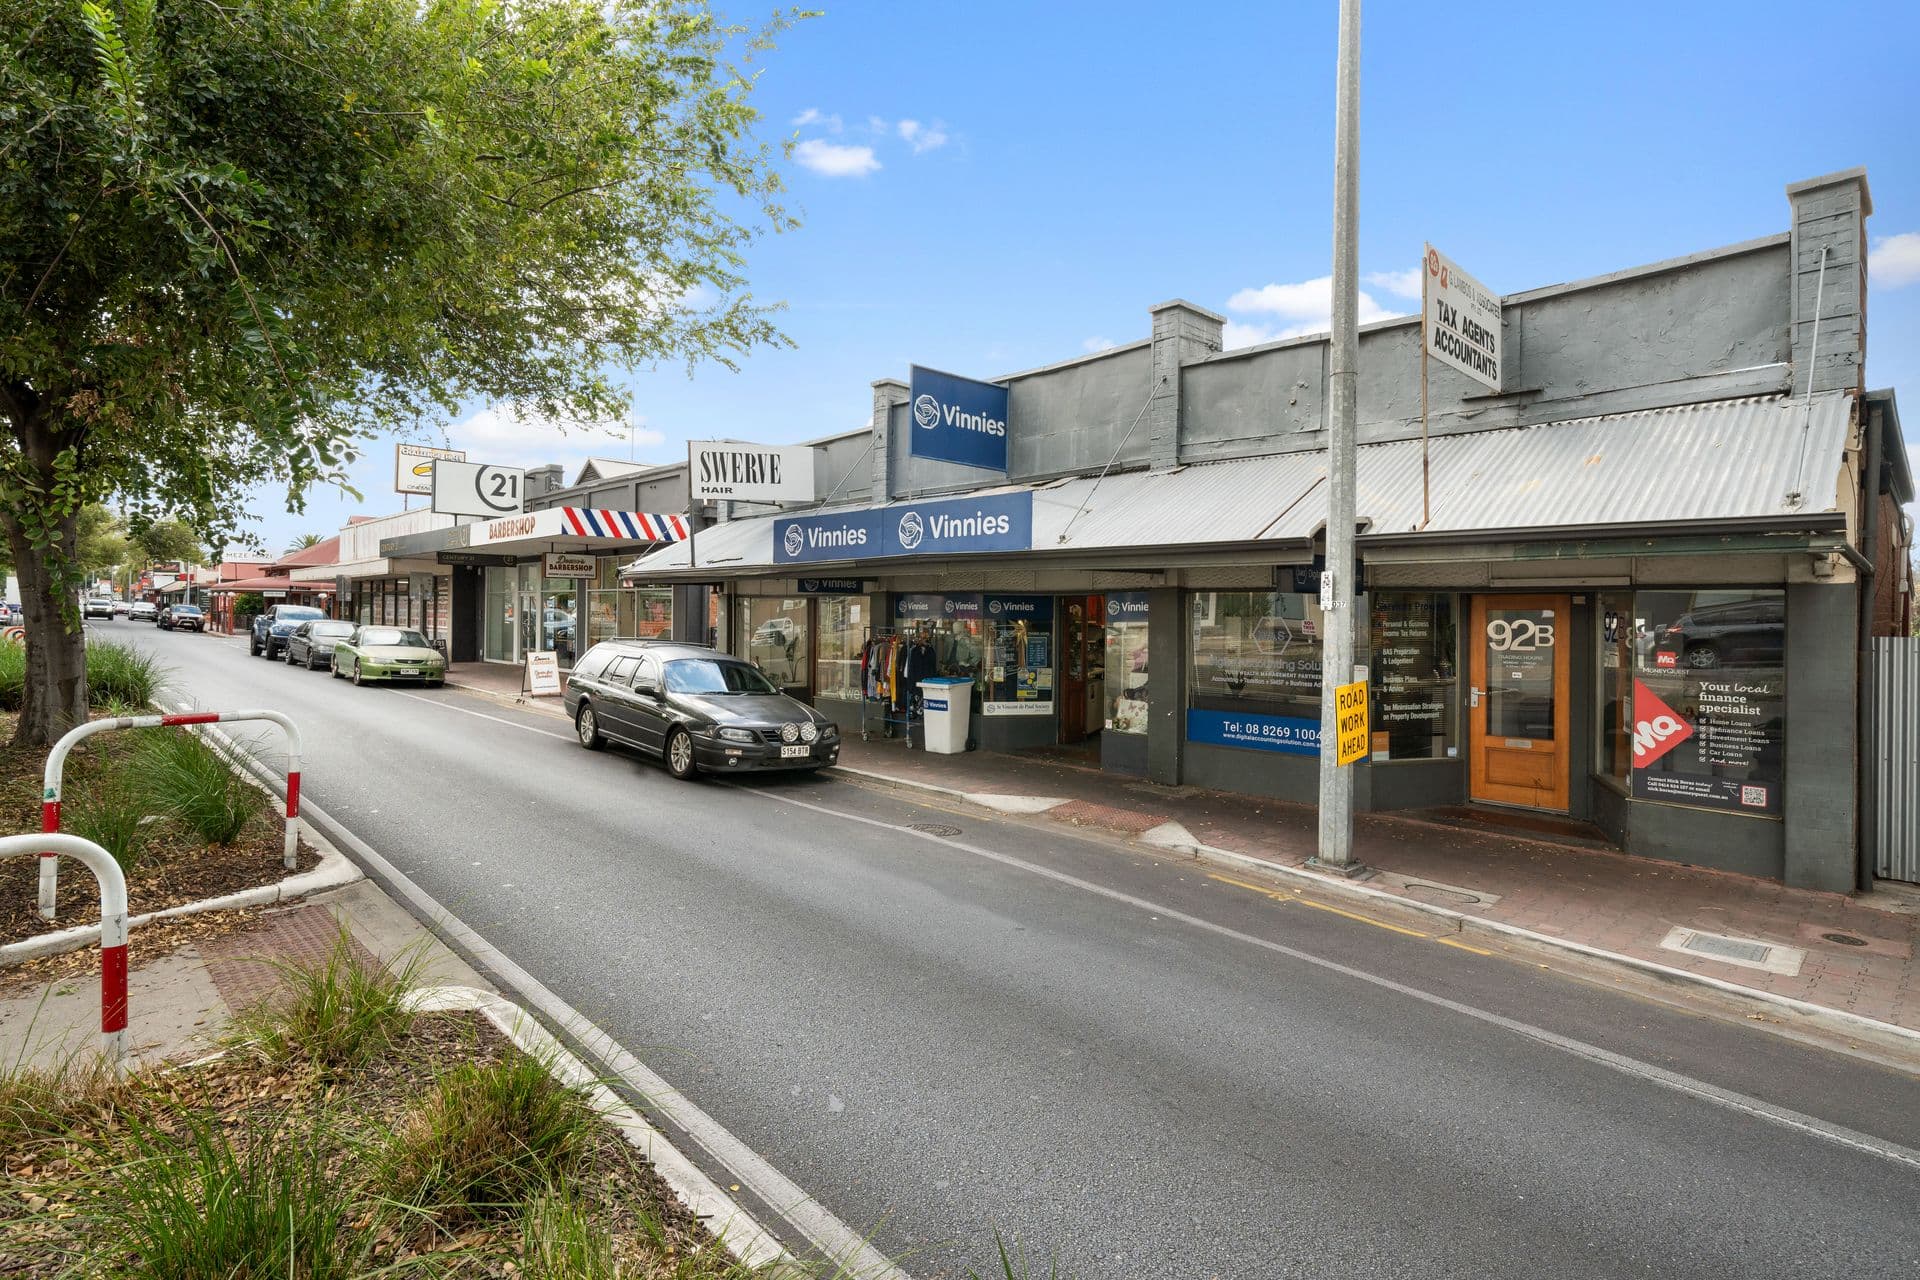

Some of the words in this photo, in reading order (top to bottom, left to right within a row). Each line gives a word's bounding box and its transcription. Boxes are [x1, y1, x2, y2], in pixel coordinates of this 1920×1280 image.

[1437, 298, 1457, 330] TAX
[1462, 316, 1495, 354] AGENTS
[1434, 327, 1497, 381] ACCOUNTANTS
[943, 404, 1006, 437] Vinnies
[700, 451, 781, 485] SWERVE
[701, 486, 733, 494] HAIR
[489, 516, 536, 540] BARBERSHOP
[929, 511, 1009, 539] Vinnies
[808, 525, 867, 549] Vinnies
[549, 564, 593, 572] BARBERSHOP
[822, 579, 856, 588] Vinnies
[908, 601, 928, 611] Vinnies
[955, 601, 978, 611] Vinnies
[1003, 602, 1034, 611] Vinnies
[1121, 601, 1149, 612] Vinnie
[1486, 619, 1555, 651] 92B
[1394, 649, 1420, 657] Preparation
[1300, 660, 1323, 671] Solu
[1699, 682, 1730, 692] Your
[1734, 683, 1770, 693] local
[1340, 689, 1364, 711] ROAD
[1699, 693, 1746, 703] finance
[1699, 704, 1761, 715] specialist
[1390, 713, 1410, 721] Property
[1410, 712, 1440, 721] Development
[1341, 714, 1365, 733] WORK
[1223, 721, 1243, 733] Tel:
[1245, 723, 1259, 735] 08
[1262, 724, 1290, 738] 8269
[1710, 734, 1747, 742] Investment
[1342, 734, 1366, 757] AHEAD
[1710, 742, 1739, 750] Business
[782, 747, 796, 756] S154
